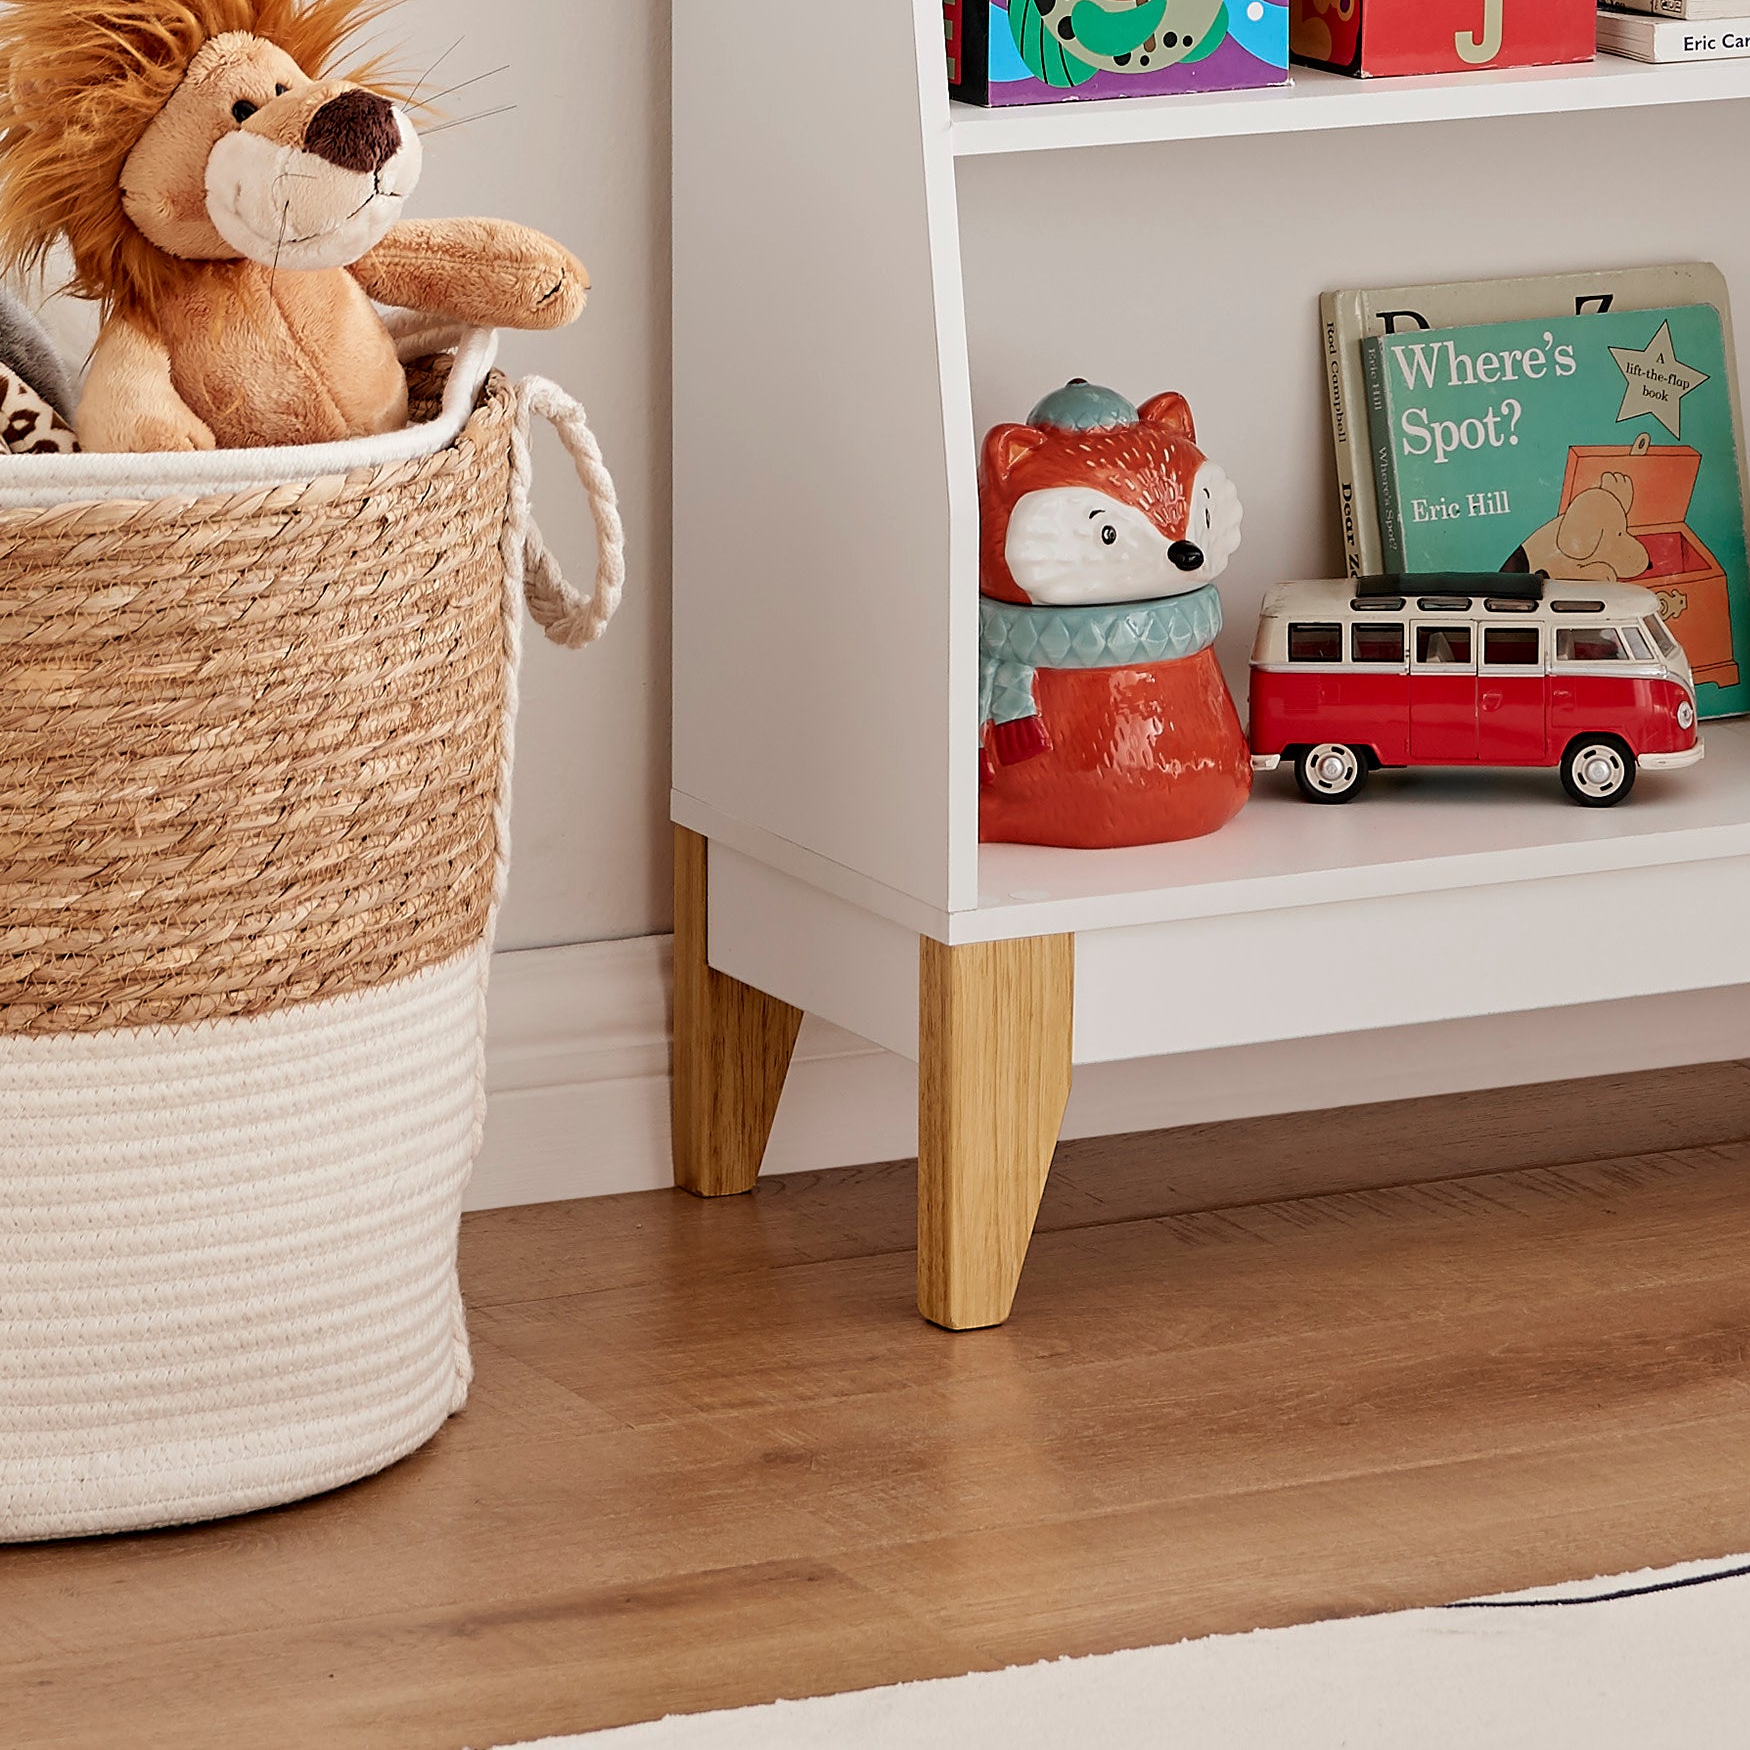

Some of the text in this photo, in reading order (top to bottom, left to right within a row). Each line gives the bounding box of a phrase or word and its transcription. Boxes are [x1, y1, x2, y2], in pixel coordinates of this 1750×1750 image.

[1683, 35, 1716, 52] Eric
[1327, 322, 1337, 355] Rod
[1368, 347, 1378, 380] Eric
[1391, 331, 1577, 391] Where's
[1656, 352, 1665, 364] A
[1625, 362, 1690, 390] lift-the-flap
[1331, 360, 1347, 443] Campbell
[1642, 384, 1669, 402] book
[1401, 397, 1522, 464] Spot?
[1378, 446, 1392, 507] Where's
[1340, 482, 1355, 546] Dear
[1411, 490, 1511, 523] Eric Hill
[1384, 508, 1398, 551] Spot?
